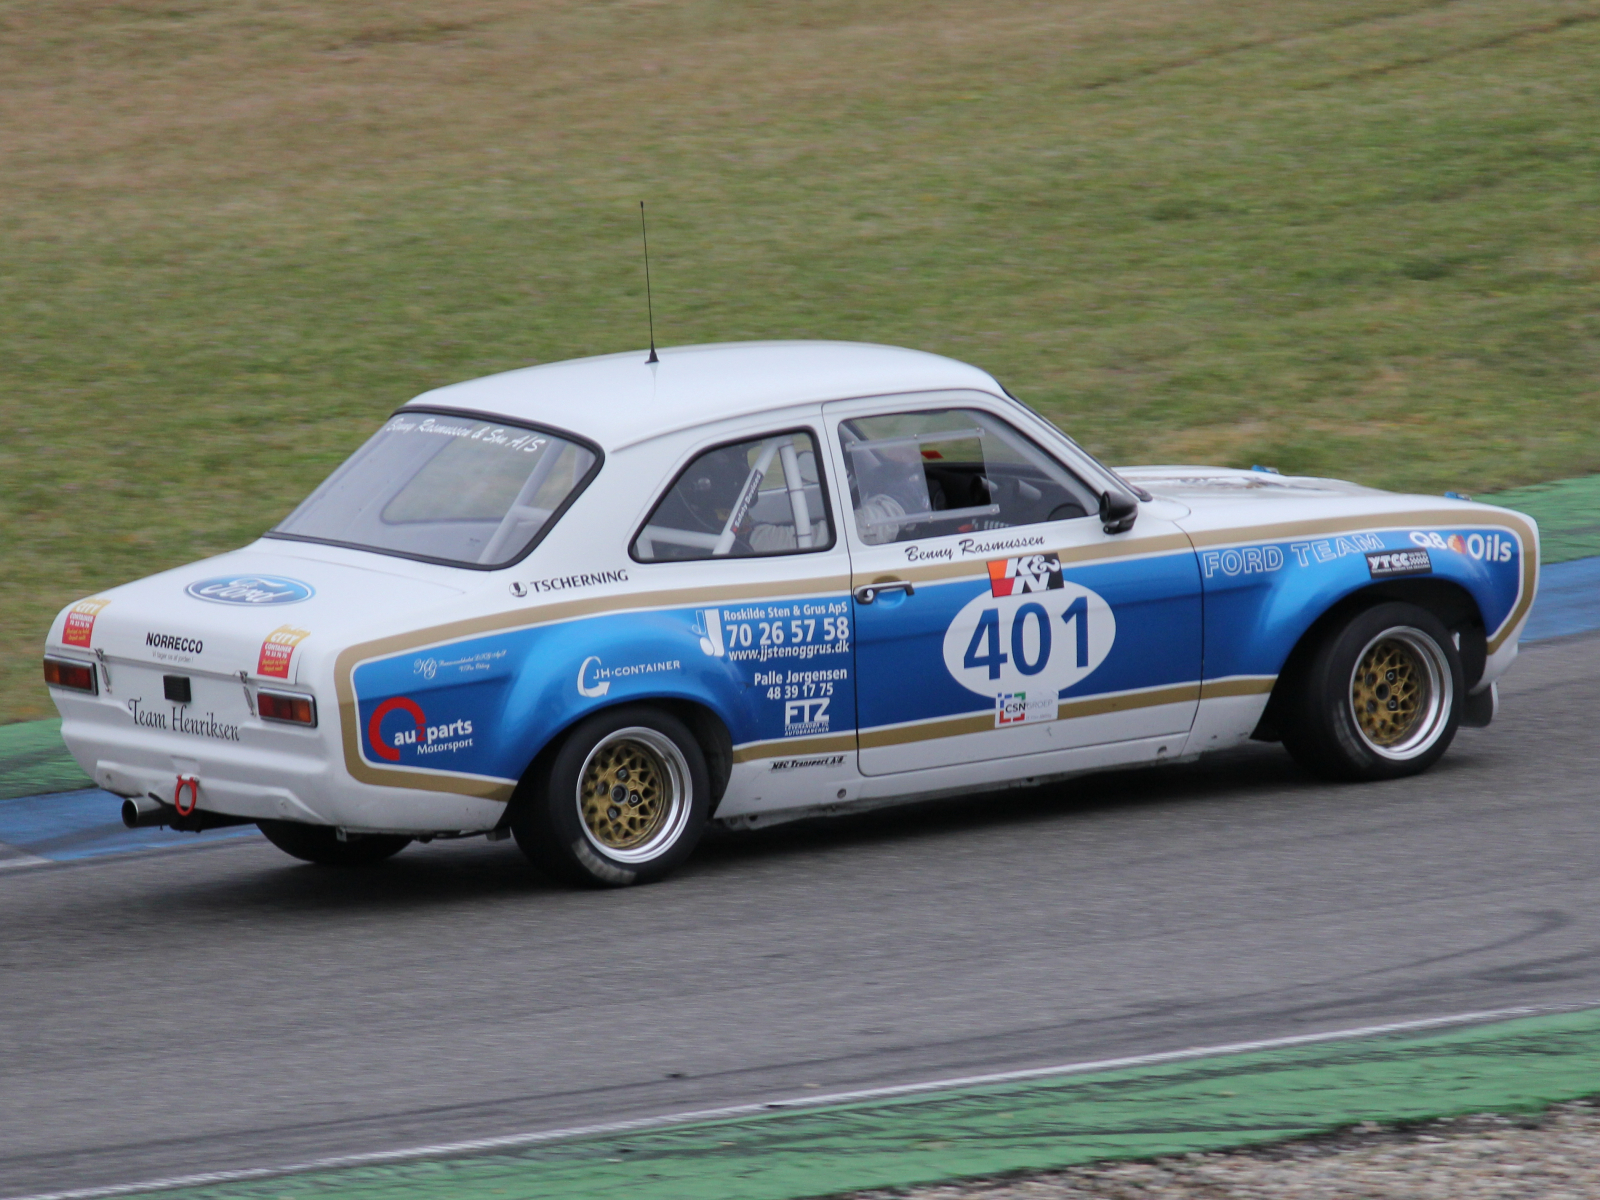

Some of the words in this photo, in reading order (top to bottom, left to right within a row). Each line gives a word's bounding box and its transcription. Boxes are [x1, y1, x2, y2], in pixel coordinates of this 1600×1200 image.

[505, 435, 546, 452] A/S
[904, 545, 954, 562] Benny
[958, 535, 1046, 556] Rasmussen
[1202, 546, 1284, 578] FORD
[1290, 533, 1386, 567] TEAM
[1409, 531, 1447, 549] Q8
[1467, 533, 1512, 562] Oils
[1367, 552, 1411, 569] YTCC
[199, 577, 294, 603] Ford
[530, 569, 629, 593] TSCHERNING
[75, 602, 101, 613] CITY
[724, 607, 765, 621] Roskilde
[768, 607, 790, 618] Sten
[793, 605, 801, 616] &
[803, 604, 826, 615] Grus
[828, 602, 847, 614] ApS
[145, 632, 203, 654] NORRECCO
[271, 633, 299, 644] CITY
[726, 623, 752, 648] 70
[759, 621, 784, 645] 26
[791, 619, 816, 643] 57
[823, 616, 850, 641] 58
[963, 595, 1089, 681] 401
[728, 640, 850, 662] www.jjstenoggrus.dk
[754, 670, 783, 686] Palle
[785, 668, 848, 686] Jørgensen
[766, 686, 781, 700] 48
[784, 685, 799, 699] 39
[802, 683, 816, 697] 17
[819, 682, 834, 696] 75
[785, 697, 830, 725] FTZ
[1005, 702, 1026, 714] CSN
[128, 697, 167, 730] Team
[172, 704, 240, 742] Henriksen
[394, 718, 473, 746] au2parts
[417, 738, 473, 755] Motorsport
